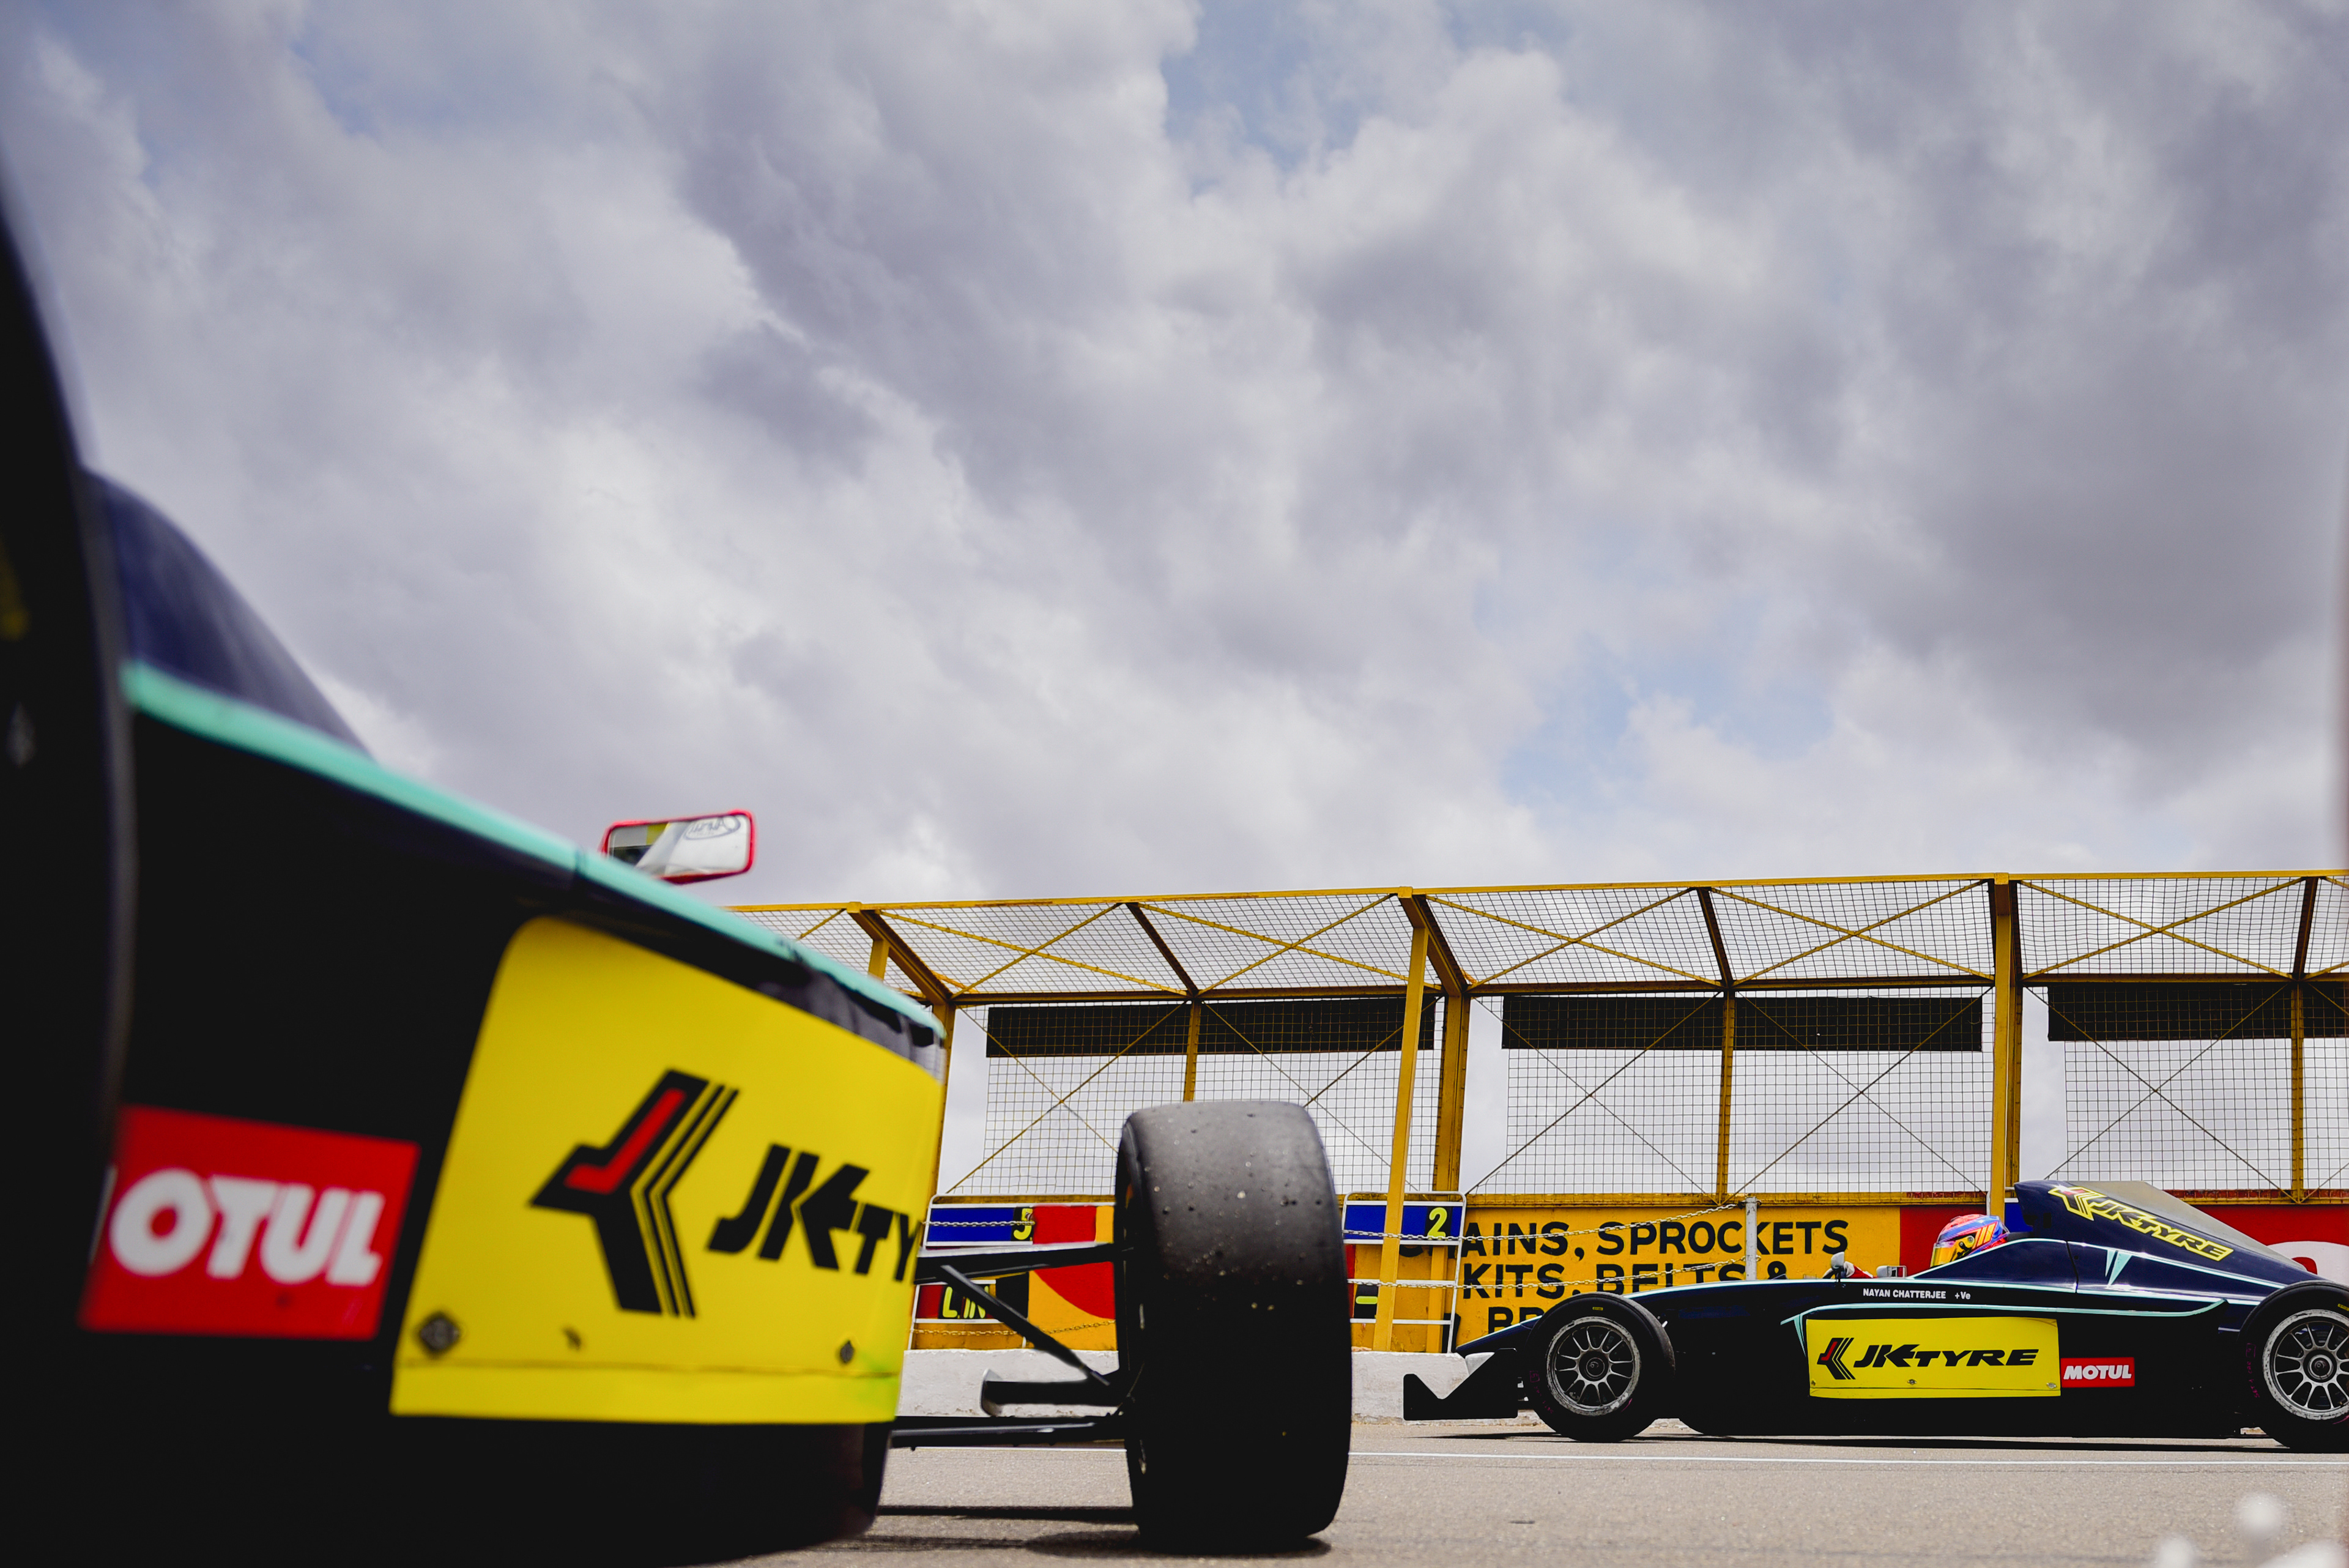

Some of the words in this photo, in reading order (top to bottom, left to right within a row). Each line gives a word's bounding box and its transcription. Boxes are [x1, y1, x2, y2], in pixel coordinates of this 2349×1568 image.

[92, 1166, 384, 1287] OTUL
[1427, 1207, 1447, 1240] 2
[1399, 1221, 1584, 1261] AINS,
[1596, 1221, 1849, 1255] SPROCKETS
[1863, 1288, 1890, 1298] NAYAN
[1892, 1289, 1946, 1299] CHATTERJEE
[2063, 1364, 2132, 1380] MOTUL
